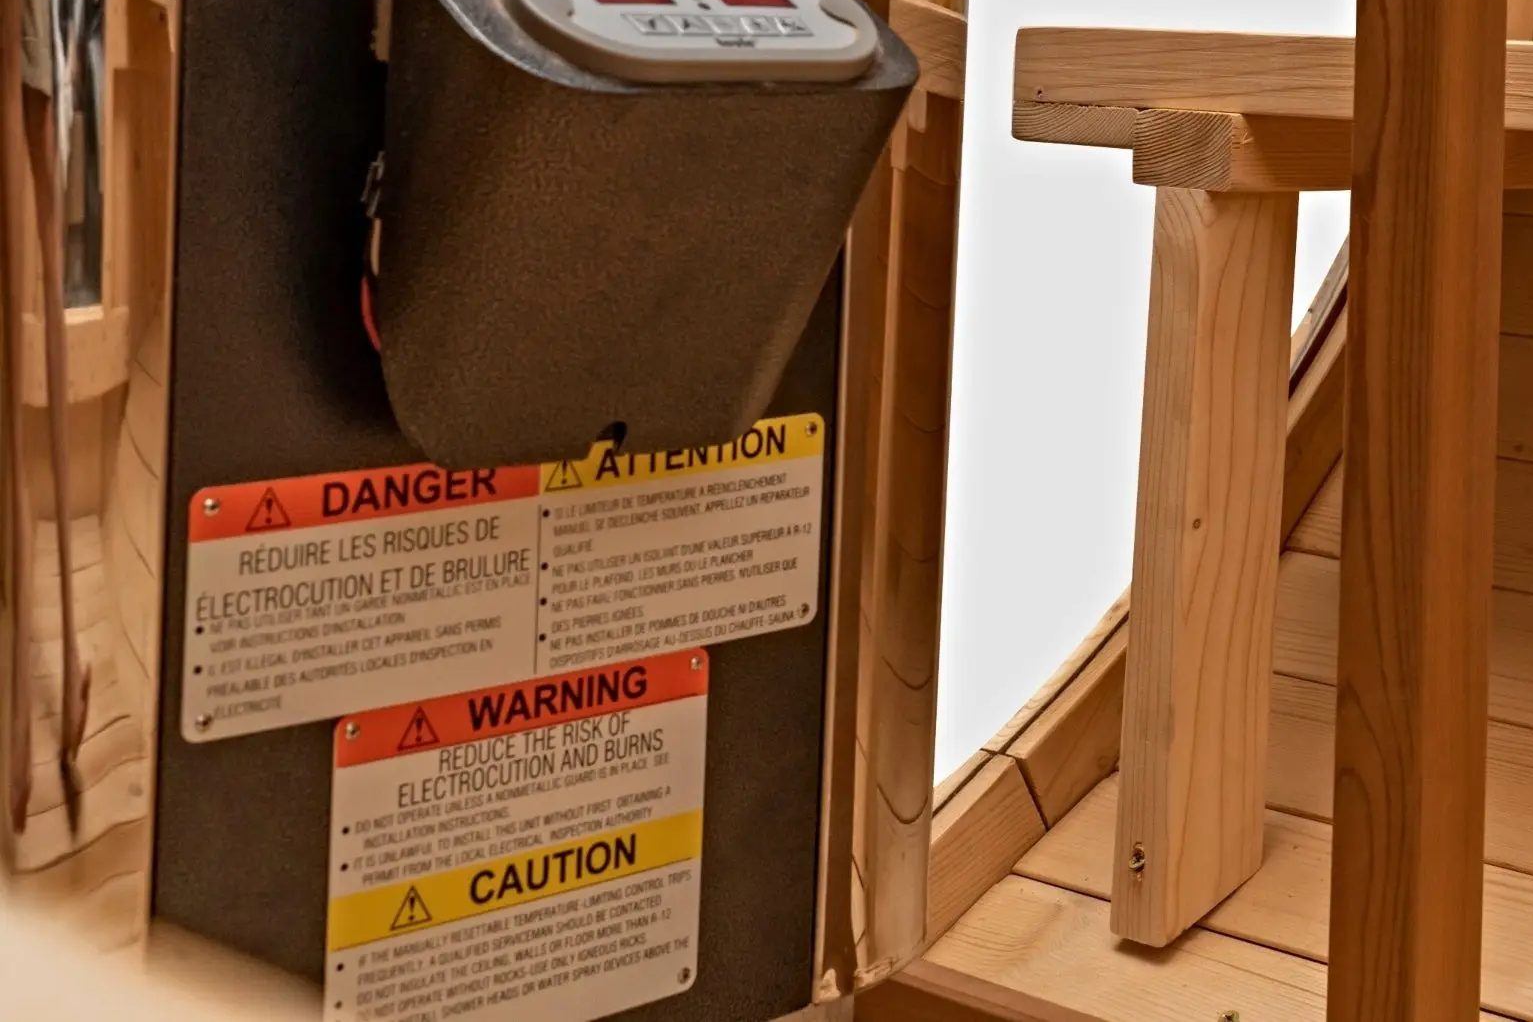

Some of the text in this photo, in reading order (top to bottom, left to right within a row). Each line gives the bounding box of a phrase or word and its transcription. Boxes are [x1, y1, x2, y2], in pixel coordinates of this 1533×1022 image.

[323, 468, 496, 517] DANGER
[239, 515, 500, 575] RÉDUIRE LES RISQUES DE
[196, 547, 530, 622] ÉLECTROCUTION ET DE BRULURE
[436, 622, 461, 638] SANS
[468, 666, 647, 731] WARNING
[398, 728, 663, 808] ELECTROCUTION AND BURNS
[439, 710, 630, 773] REDUCE THE RISK OF
[363, 822, 435, 850] INSTALLATION
[396, 803, 440, 824] OPERATE
[445, 793, 483, 813] UNLESS
[486, 791, 492, 804] A
[438, 836, 449, 850] TO
[452, 826, 490, 847] INSTALL
[495, 820, 516, 837] THIS
[543, 804, 584, 826] WITHOUT
[586, 798, 610, 816] FIRST
[435, 853, 451, 868] THE
[470, 832, 635, 906] CAUTION
[625, 876, 663, 897] CONTROL
[668, 868, 691, 886] TRIPS
[556, 912, 592, 933] SHOULD
[595, 908, 606, 923] BE
[609, 894, 661, 919] CONTACTED
[374, 983, 395, 1001] NOT
[451, 964, 467, 980] THE
[515, 942, 546, 962] WALLS
[549, 937, 561, 953] OR
[565, 929, 593, 948] FLOOR
[596, 921, 621, 939] MORE
[625, 914, 648, 931] THAN
[398, 988, 441, 1012] OPERATE
[446, 975, 490, 998] WITHOUT
[550, 952, 574, 969] ONLY
[441, 994, 483, 1020] SHOWER
[486, 984, 518, 1007] HEADS
[537, 970, 568, 992] WATER
[572, 961, 600, 982] SPRAY
[643, 941, 670, 962] ABOVE
[673, 936, 689, 953] THE
